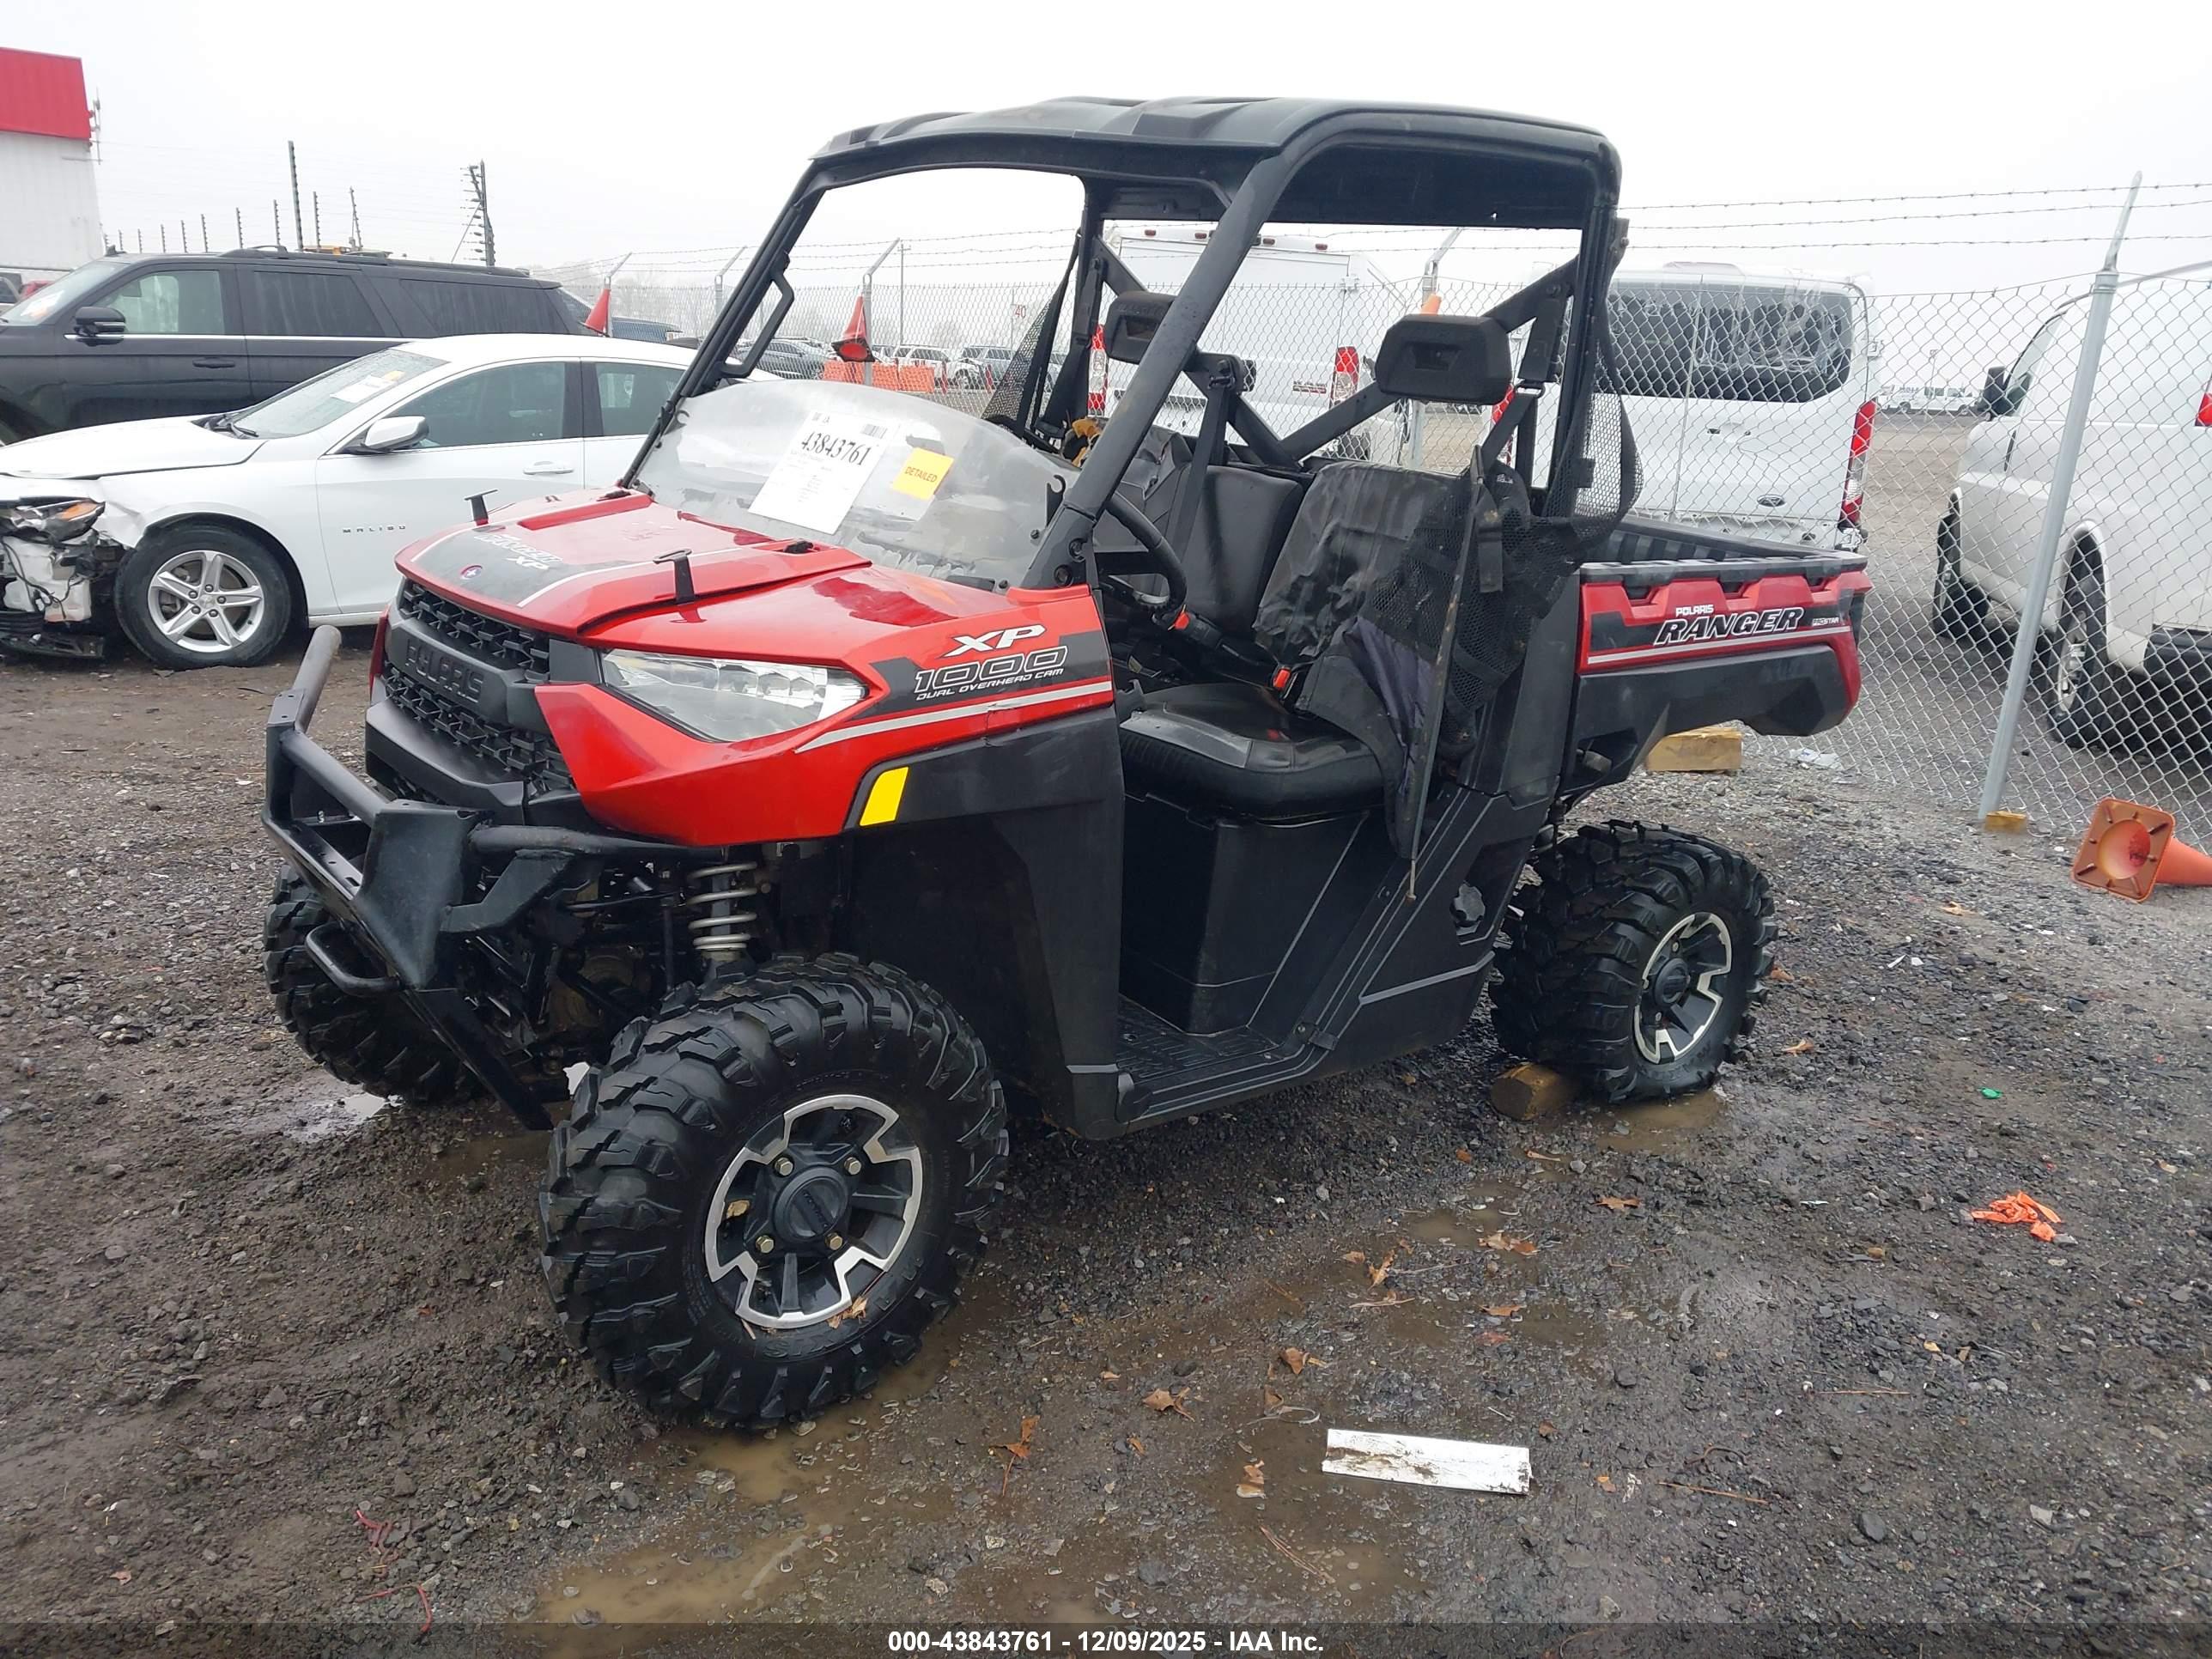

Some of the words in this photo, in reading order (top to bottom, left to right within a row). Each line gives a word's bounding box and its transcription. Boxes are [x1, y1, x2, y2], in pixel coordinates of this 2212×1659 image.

[801, 431, 872, 465] 43843761
[904, 465, 938, 485] DETAILED
[343, 525, 406, 533] MALIBU
[505, 555, 550, 569] XP
[1676, 604, 1714, 616] POLARIS
[944, 624, 1047, 658] XP
[1654, 607, 1804, 647] RANGER
[405, 639, 484, 703] POLARIS
[914, 646, 1067, 694] 1000
[916, 688, 956, 701] DUAL
[959, 673, 1033, 693] OVERHEAD
[1035, 668, 1064, 681] CAM
